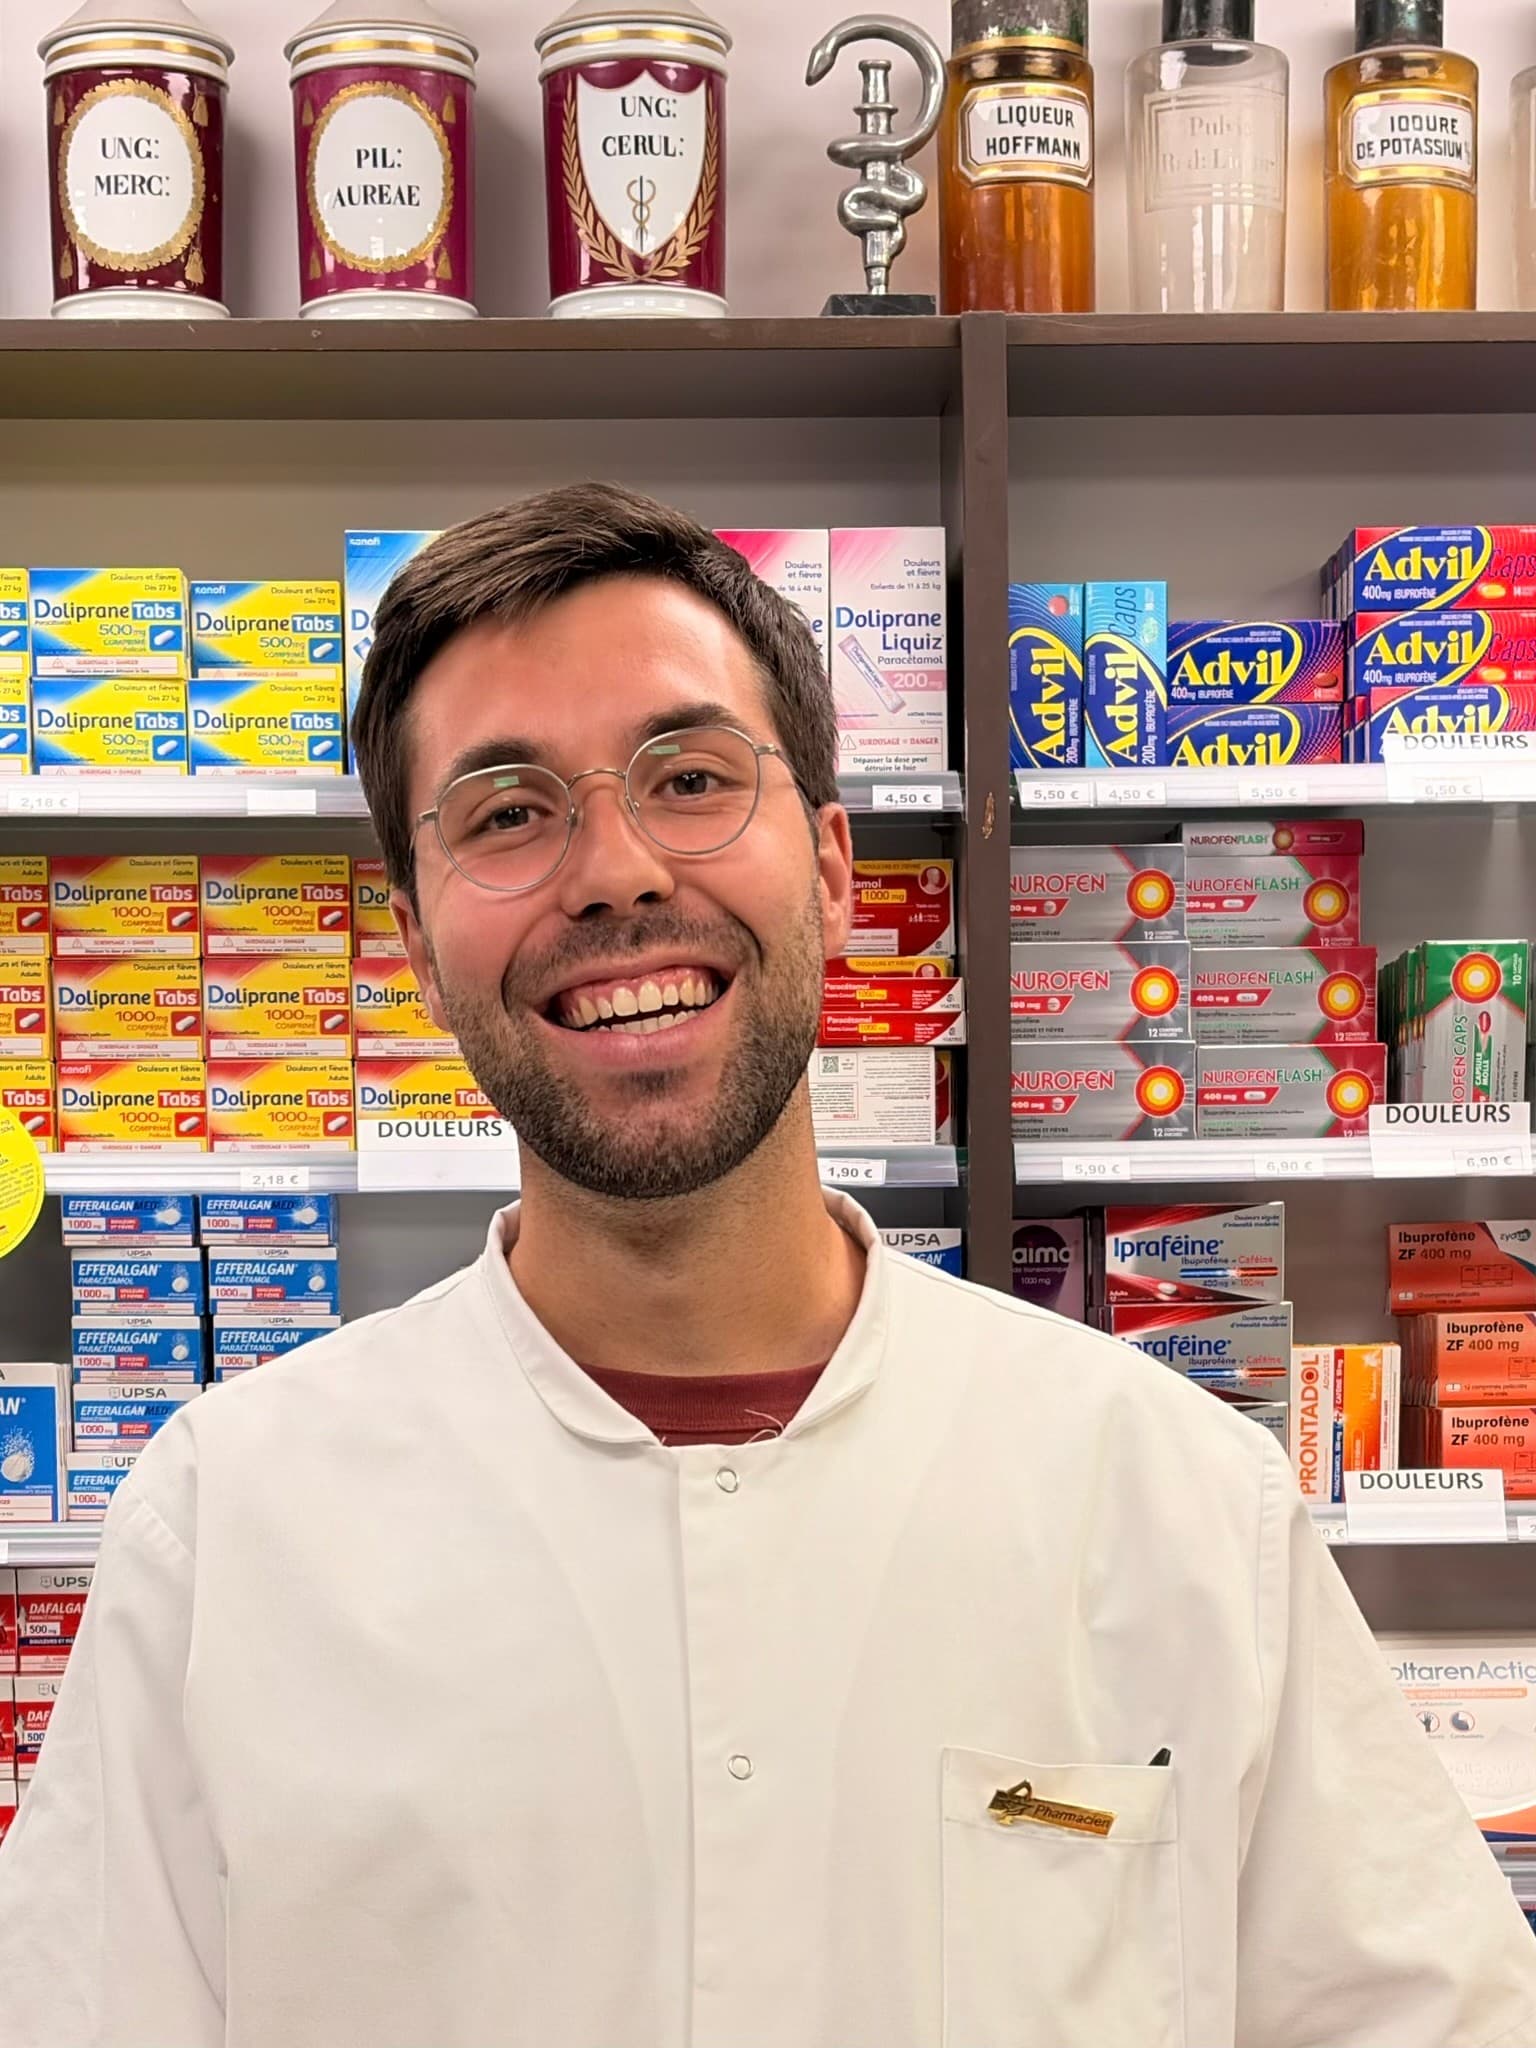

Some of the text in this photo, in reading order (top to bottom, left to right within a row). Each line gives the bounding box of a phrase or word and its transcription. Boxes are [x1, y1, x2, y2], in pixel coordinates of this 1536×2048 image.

[620, 96, 677, 119] UNG:
[997, 105, 1075, 128] LIQUEUR
[1390, 115, 1459, 135] IODURE
[101, 137, 160, 160] UNG:
[602, 135, 684, 158] CERUL:
[986, 136, 1081, 160] HOFFMANN
[1356, 138, 1463, 160] DE POTASSIUM
[356, 147, 402, 170] PIL:
[95, 174, 171, 198] MERC:
[332, 185, 420, 208] AUREAE
[785, 561, 823, 569] Douleurs
[903, 559, 941, 567] Douleurs
[1364, 546, 1474, 581] Advil
[34, 599, 176, 622] Doliprane Tabs
[1108, 587, 1142, 638] Caps
[196, 612, 290, 635] Doliprane
[292, 616, 334, 631] Tabs
[835, 606, 942, 632] Doliprane
[882, 633, 942, 657] Liquiz
[1365, 630, 1473, 665] Advil
[878, 655, 943, 665] Paracétamol
[1172, 649, 1283, 686] Advil
[1031, 648, 1066, 763] Advil
[1105, 653, 1139, 763] Advil
[38, 709, 178, 732] Doliprane Tabs
[194, 710, 334, 732] Doliprane Tabs
[1386, 704, 1490, 734] Advil
[1172, 733, 1282, 767] Advil
[1403, 735, 1528, 750] DOULEURS
[884, 793, 932, 805] 4,50 €
[1034, 790, 1079, 802] 5,50 €
[1108, 790, 1156, 802] 4,50 €
[1010, 874, 1105, 893] NUROFEN
[2, 886, 43, 900] Tabs
[54, 882, 193, 904] Doliprane Tabs
[206, 881, 299, 903] Doliprane
[304, 885, 344, 900] Tabs
[864, 891, 889, 900] 1000
[1144, 931, 1154, 940] 12
[1320, 938, 1330, 946] 12
[1010, 971, 1109, 990] NUROFEN
[1196, 971, 1314, 985] NUROFENFLASH
[0, 988, 41, 1002] Tabs
[58, 987, 198, 1009] Doliprane Tabs
[208, 985, 346, 1007] Doliprane Tabs
[1148, 1028, 1158, 1037] 12
[1334, 1033, 1344, 1041] 12
[1452, 1015, 1468, 1102] OFENCAPS
[1012, 1071, 1115, 1090] NUROFEN
[1203, 1069, 1322, 1084] NUROFENFLASH
[4, 1091, 46, 1106] Tabs
[62, 1088, 201, 1109] Doliprane Tabs
[212, 1087, 349, 1109] Doliprane Tabs
[361, 1087, 452, 1109] Doliprane
[1386, 1104, 1511, 1124] DOULEURS
[378, 1120, 502, 1138] DOULEURS
[1153, 1128, 1163, 1136] 12
[1266, 1161, 1313, 1175] 6,90 €
[1466, 1155, 1512, 1168] 6,90 €
[828, 1167, 873, 1178] 1,90 €
[1075, 1164, 1120, 1176] 5,90 €
[253, 1175, 299, 1186] 2,18 €
[69, 1220, 92, 1228] 1000
[207, 1219, 230, 1228] 1000
[886, 1233, 941, 1246] UPSA
[1399, 1231, 1475, 1245] Ibuprofène
[1113, 1235, 1220, 1262] Ipraféine
[1398, 1249, 1472, 1261] ZF 400 mg
[1181, 1256, 1229, 1266] Ibuprofène
[78, 1264, 158, 1276] EFFERALGAN
[216, 1263, 295, 1276] EFFERALGAN
[79, 1289, 102, 1297] 1000
[216, 1288, 239, 1296] 1000
[1447, 1321, 1524, 1336] Ibuprofène
[78, 1332, 158, 1344] EFFERALGAN
[220, 1331, 299, 1343] EFFERALGAN
[1122, 1335, 1227, 1362] raféine
[1447, 1339, 1520, 1352] ZF 400 mg
[79, 1357, 102, 1366] 1000
[220, 1356, 243, 1365] 1000
[1188, 1356, 1236, 1367] Ibuprofène
[122, 1387, 167, 1398] UPSA
[80, 1425, 104, 1434] 1000
[1300, 1354, 1319, 1495] PRONTADOL
[1452, 1416, 1529, 1430] Ibuprofène
[1451, 1434, 1525, 1447] ZF 400 mg
[1360, 1472, 1484, 1489] DOULEURS
[73, 1494, 96, 1503] 1000
[29, 1603, 84, 1614] DAFALGA
[29, 1625, 47, 1634] 500
[1391, 1661, 1536, 1684] oltarenActig
[1034, 1804, 1112, 1830] Pharmacien
